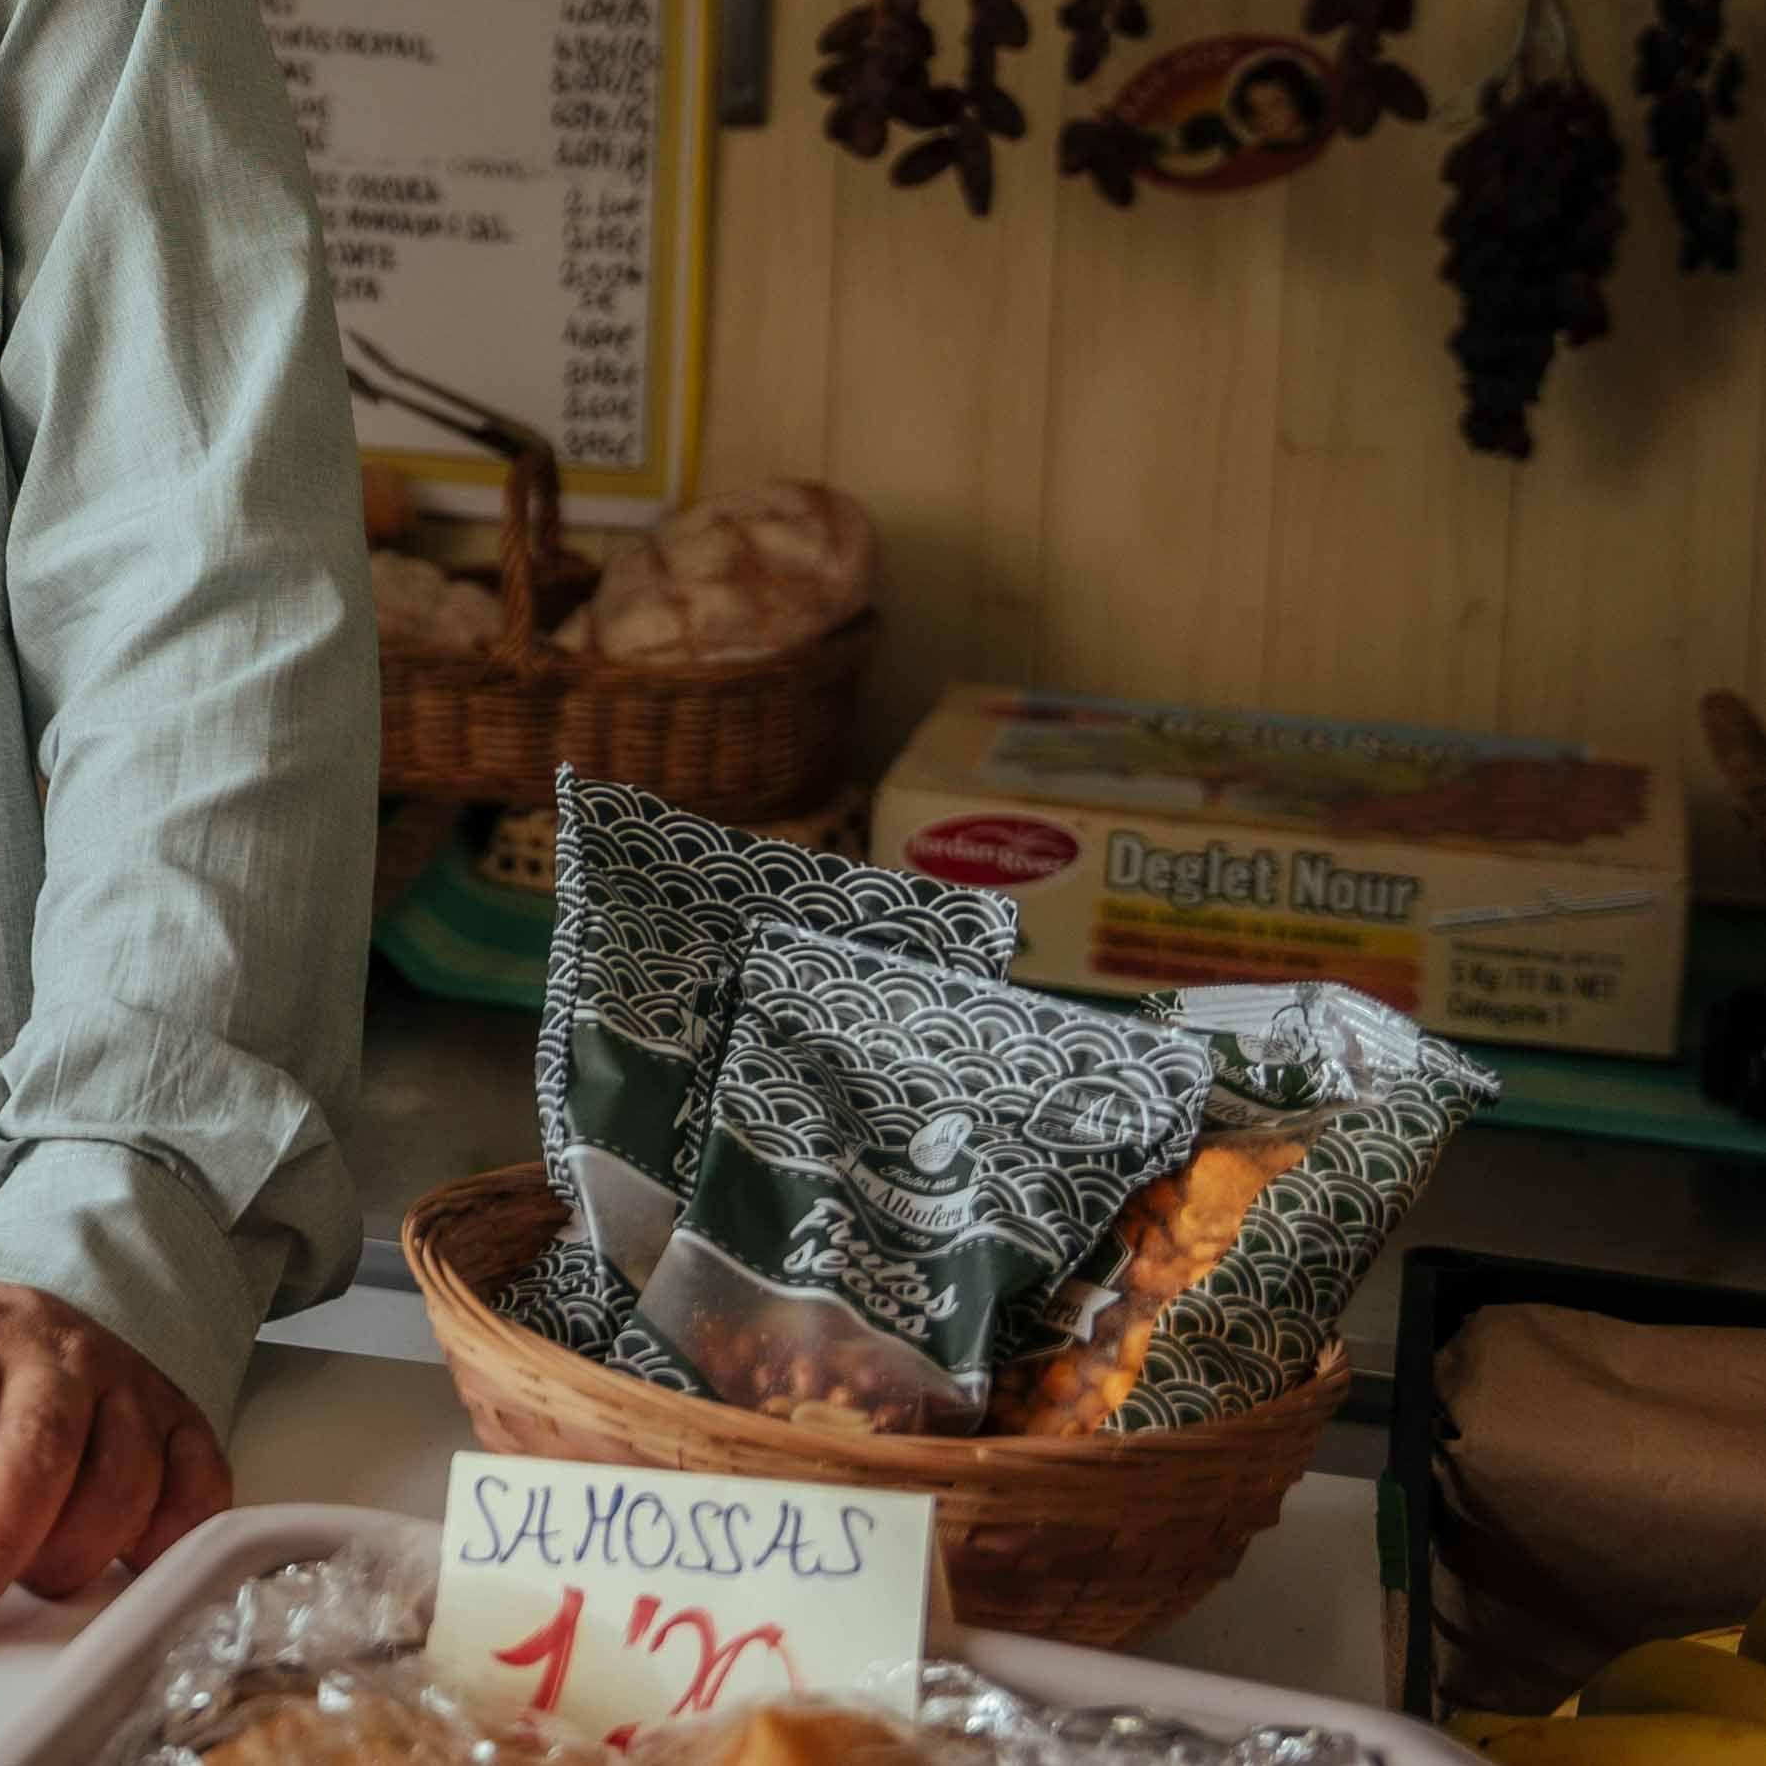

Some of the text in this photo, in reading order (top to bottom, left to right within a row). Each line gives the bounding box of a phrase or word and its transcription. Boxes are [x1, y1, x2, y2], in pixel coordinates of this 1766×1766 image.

[1105, 829, 1418, 919] Deglet Nour
[875, 1187, 964, 1229] Albufera
[789, 1196, 960, 1322] Frutos
[458, 1473, 875, 1578] SAMOSSAS
